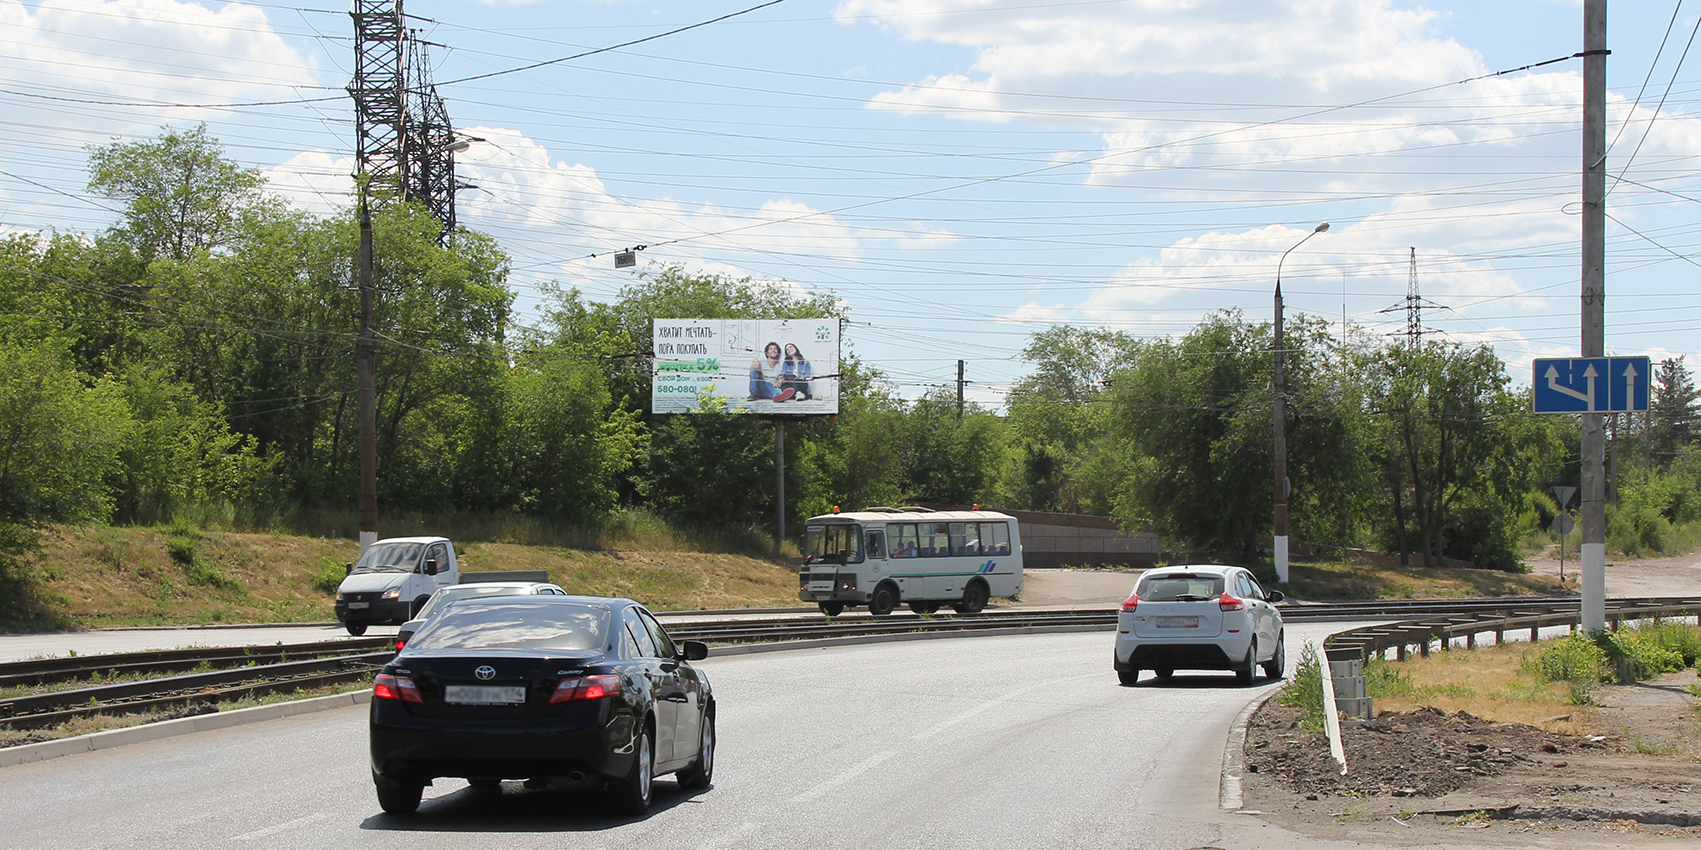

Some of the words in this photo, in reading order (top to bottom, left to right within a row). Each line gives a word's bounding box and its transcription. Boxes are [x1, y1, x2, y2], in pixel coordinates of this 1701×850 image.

[658, 327, 683, 338] ХВАТИТ
[658, 343, 674, 354] ПОРА
[677, 343, 707, 355] ПОКУПАТЬ
[697, 358, 719, 371] 5%
